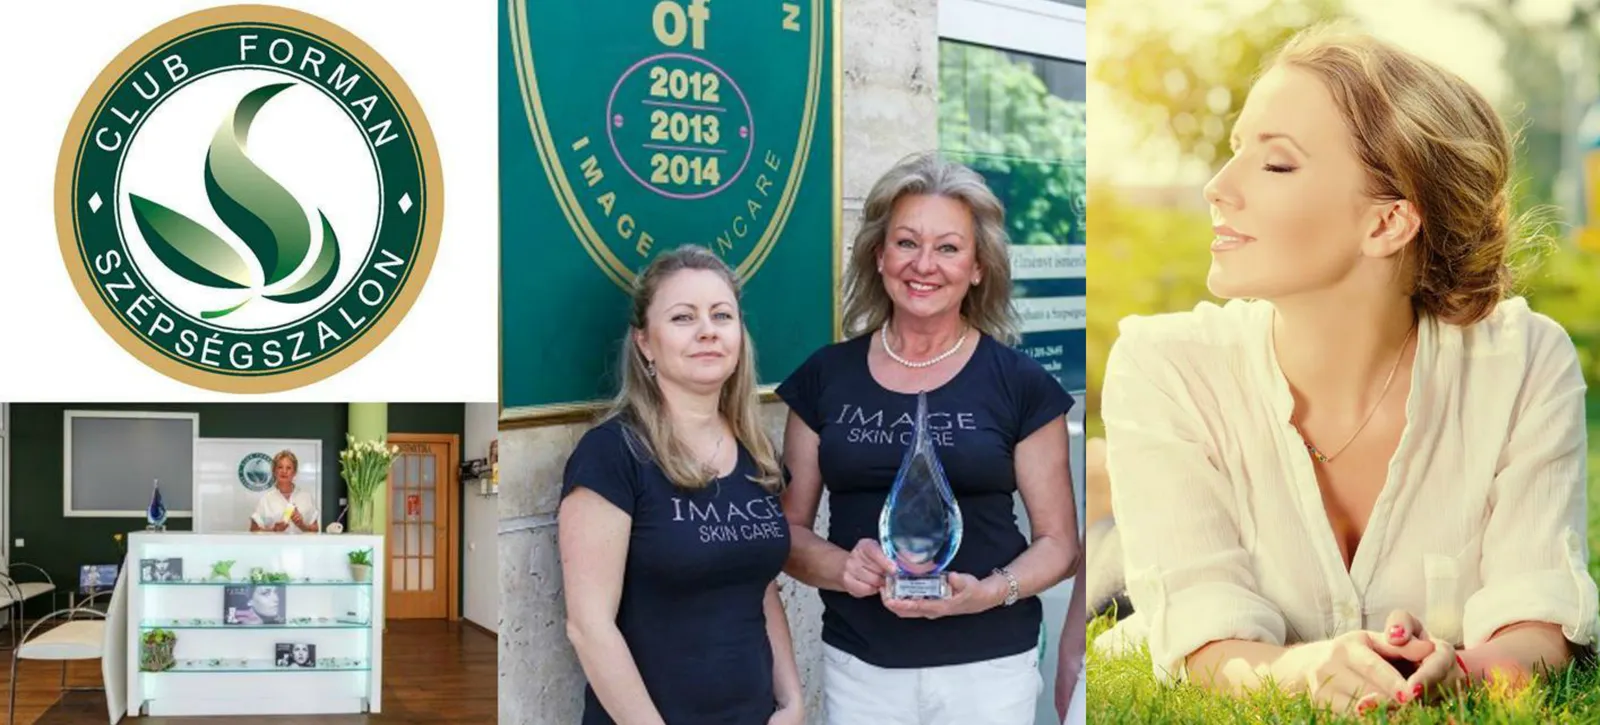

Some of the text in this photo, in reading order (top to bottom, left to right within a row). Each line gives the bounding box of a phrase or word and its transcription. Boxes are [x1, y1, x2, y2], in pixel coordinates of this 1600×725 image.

[95, 34, 399, 152] CLUB FORMAN
[650, 66, 720, 103] 2012
[650, 110, 720, 145] 2013
[650, 153, 721, 185] 2014
[571, 136, 654, 258] IMAGE
[96, 247, 405, 369] SZÉPSÉGSZALON
[836, 403, 977, 431] IMAGE
[847, 427, 954, 446] SKIN CRE
[671, 495, 784, 523] IMAGE
[699, 521, 784, 543] SKIN CARE
